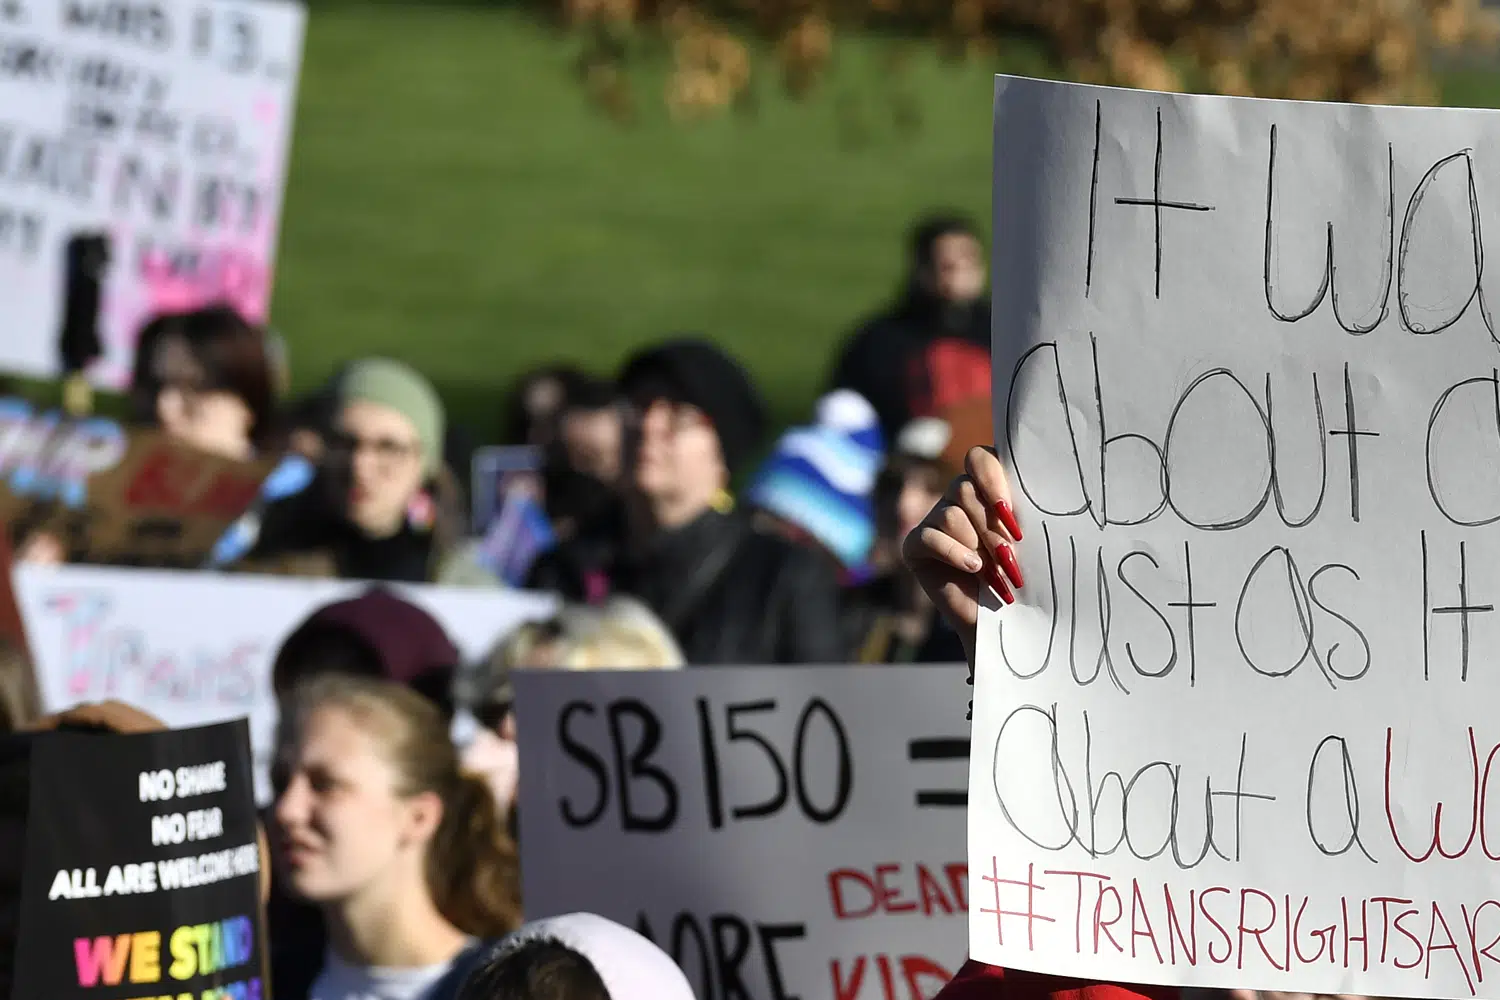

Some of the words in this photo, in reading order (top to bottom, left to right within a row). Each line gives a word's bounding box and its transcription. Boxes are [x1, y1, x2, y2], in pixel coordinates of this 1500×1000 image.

[1235, 545, 1371, 690] as
[139, 769, 175, 802] NO
[557, 698, 679, 832] SB
[697, 696, 853, 829] 150
[1307, 735, 1378, 864] a
[151, 812, 186, 846] NO
[48, 868, 101, 900] ALL
[103, 862, 157, 895] ARE
[74, 930, 161, 988] WE
